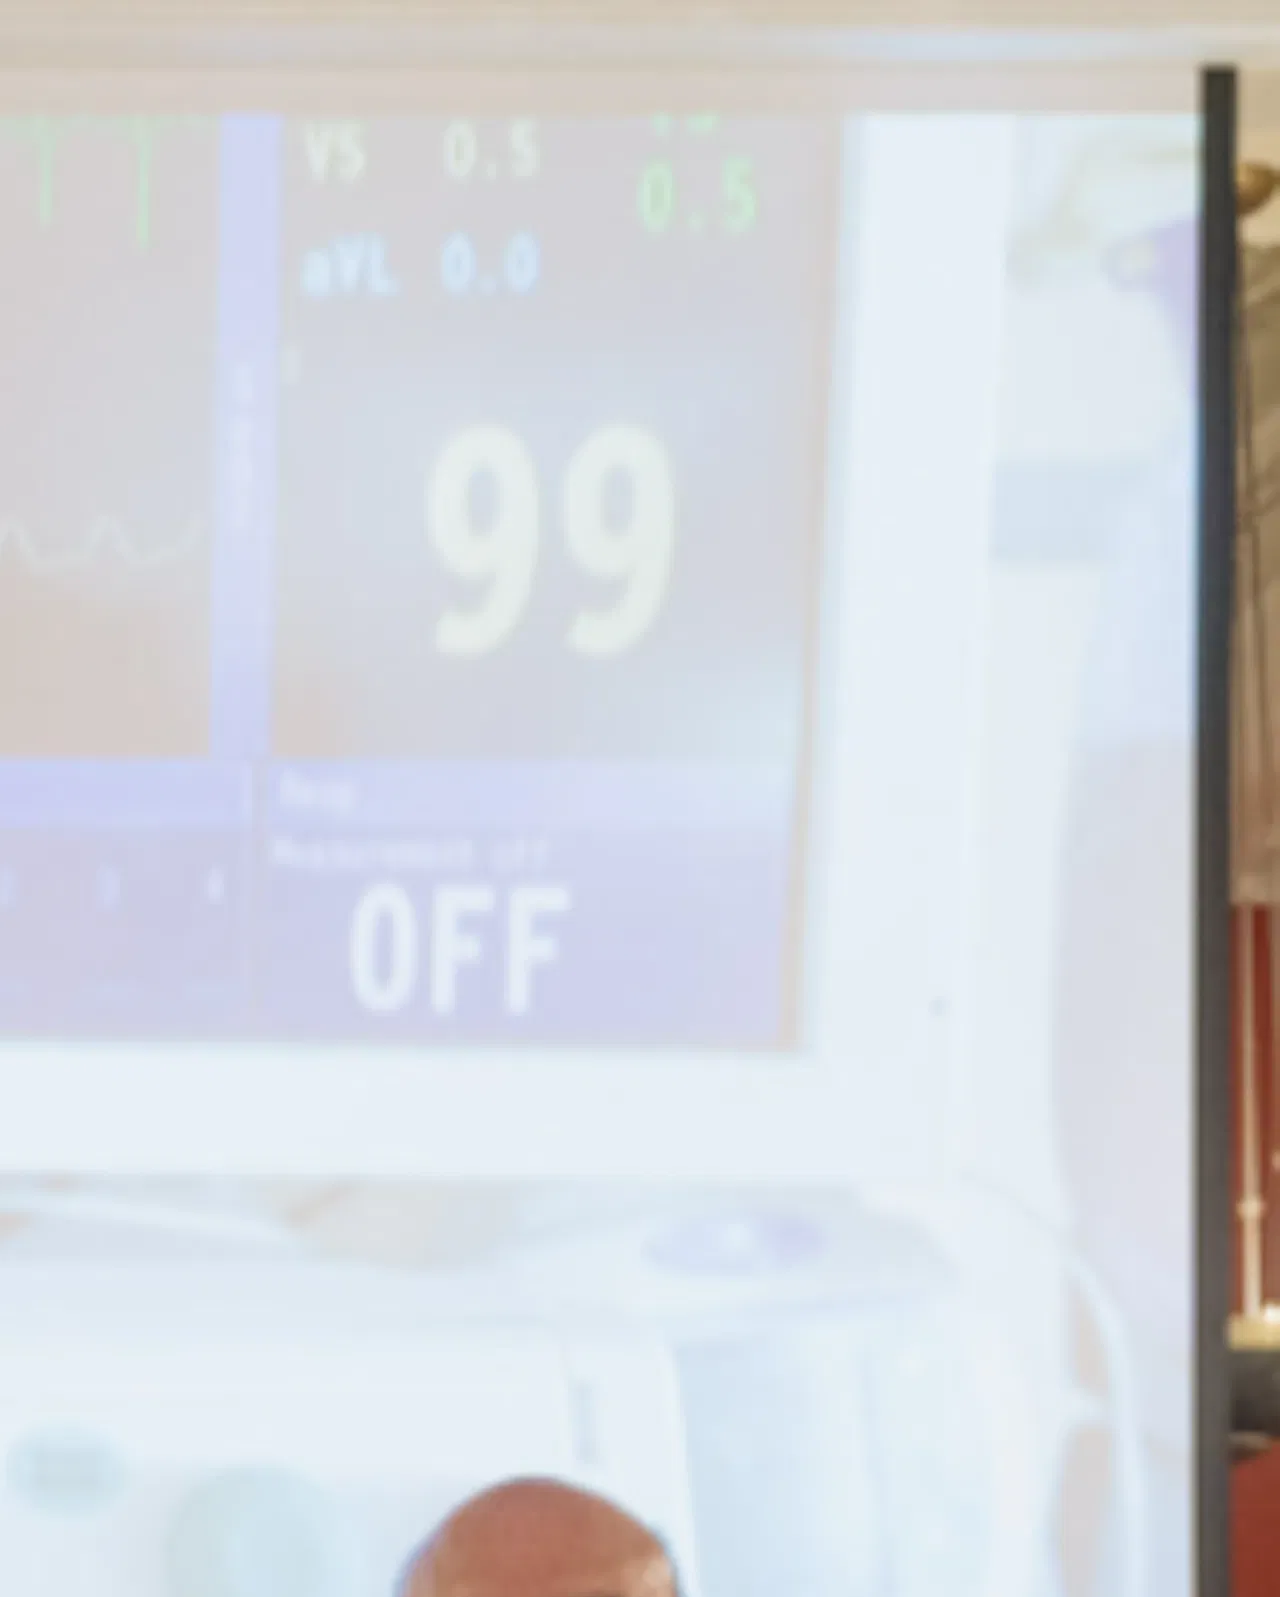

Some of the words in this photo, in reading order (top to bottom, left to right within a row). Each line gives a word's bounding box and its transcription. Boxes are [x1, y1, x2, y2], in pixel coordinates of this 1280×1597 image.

[443, 120, 539, 180] 0.5
[637, 155, 758, 238] 0.5
[440, 231, 541, 294] 0.0
[426, 421, 676, 659] 99
[350, 881, 574, 1015] OFF
